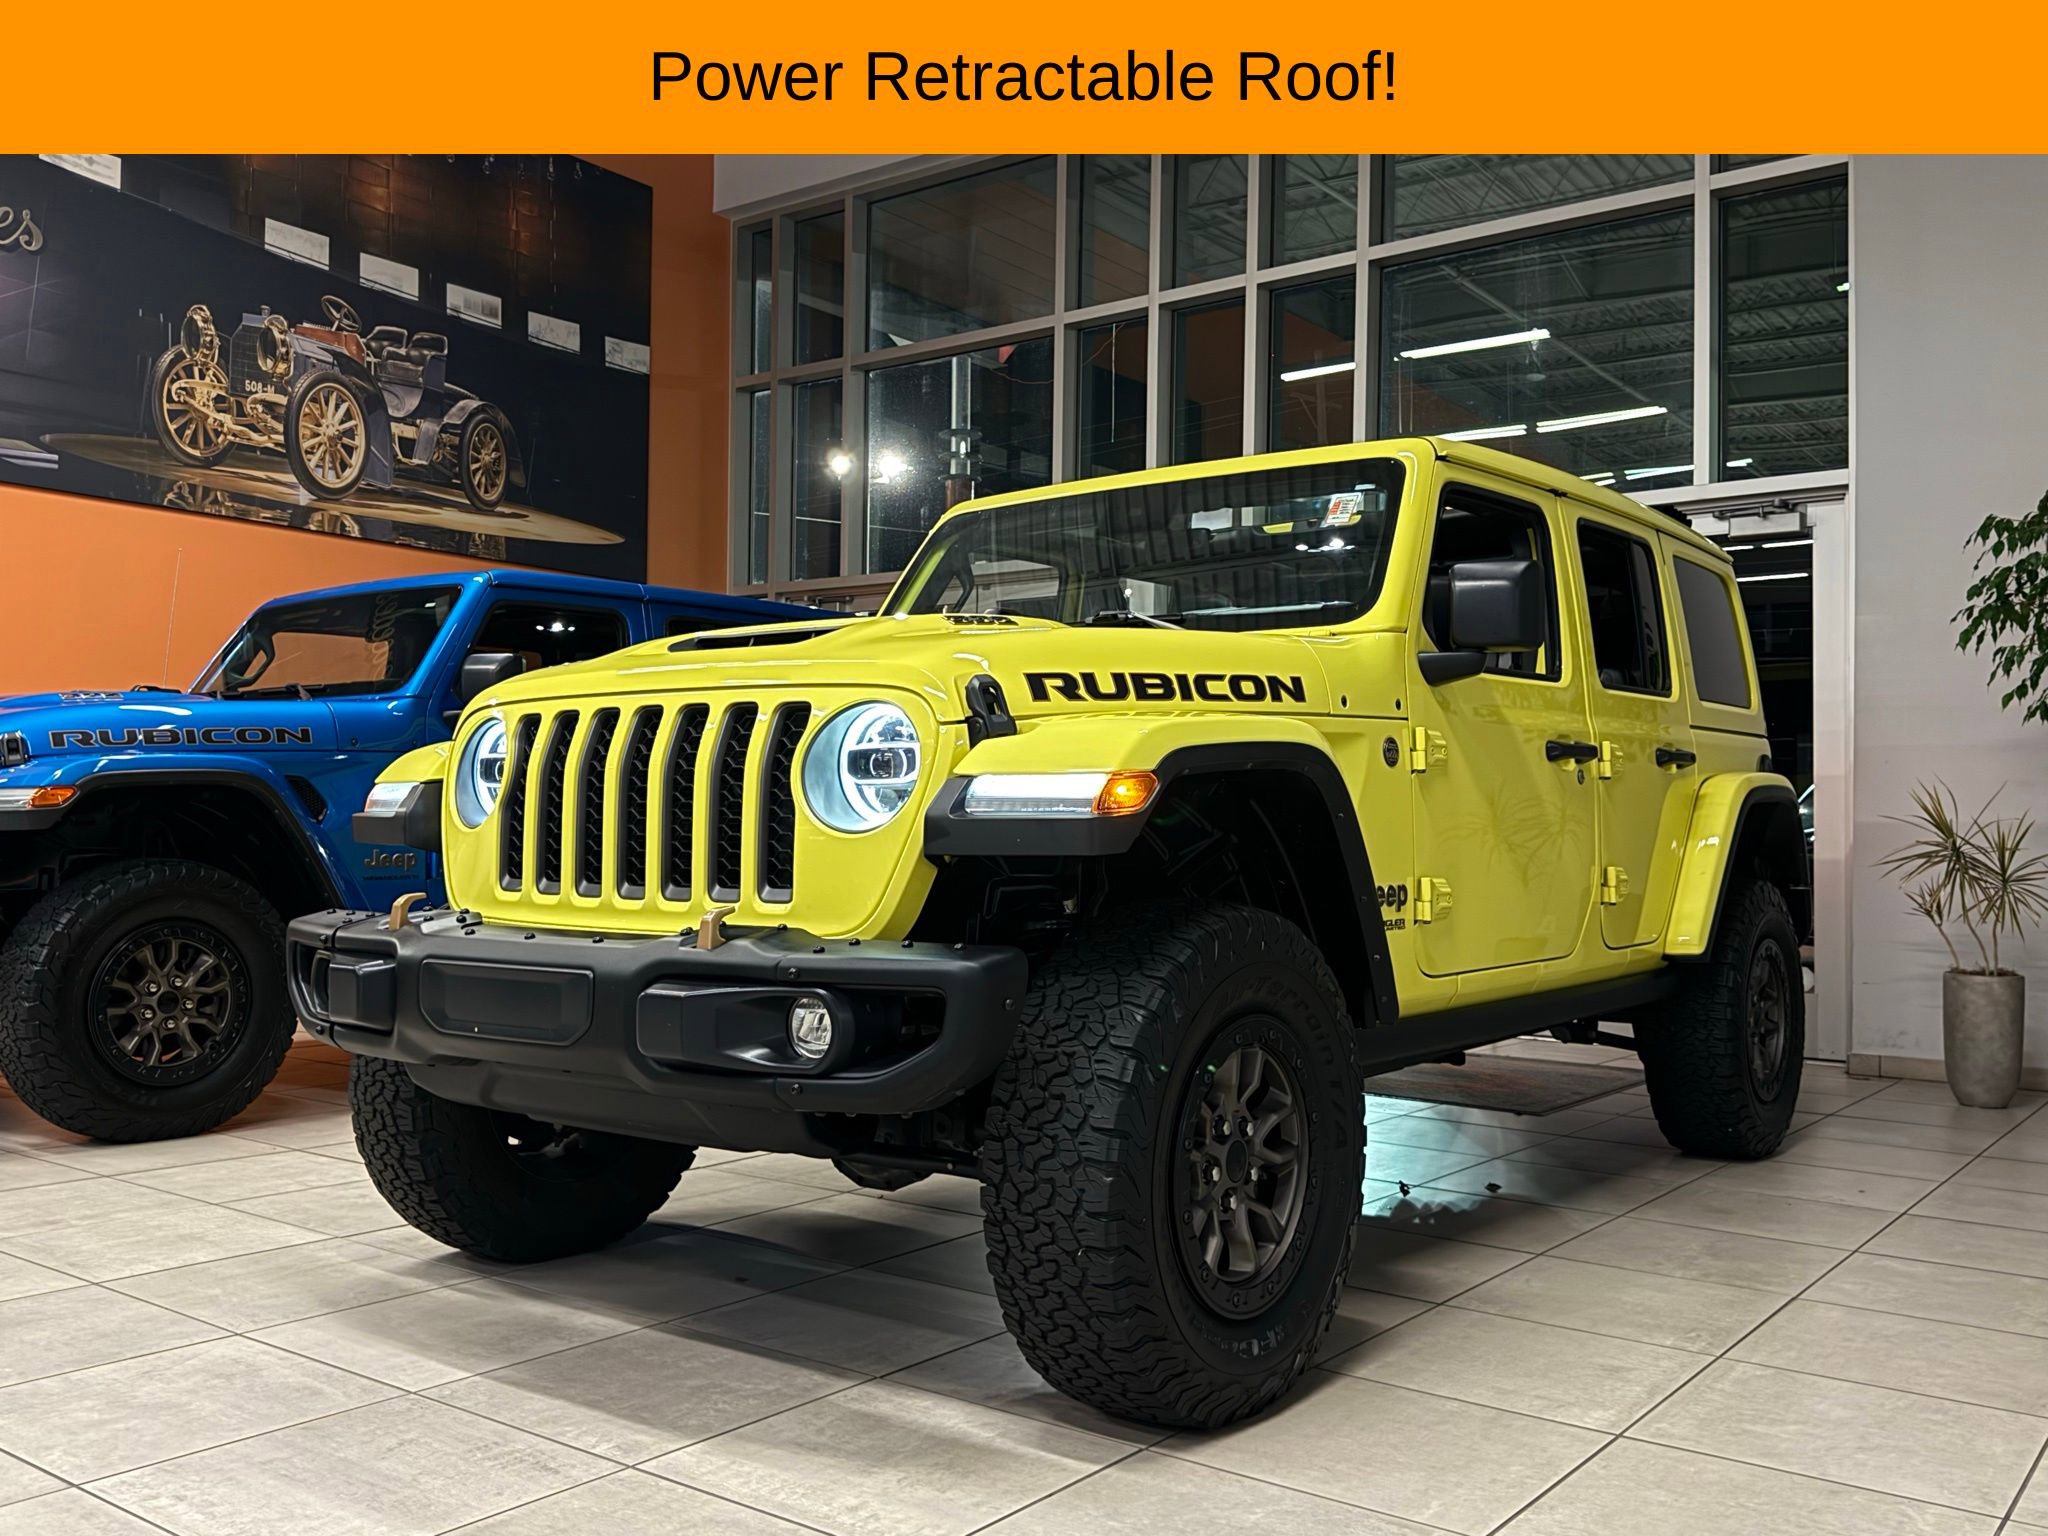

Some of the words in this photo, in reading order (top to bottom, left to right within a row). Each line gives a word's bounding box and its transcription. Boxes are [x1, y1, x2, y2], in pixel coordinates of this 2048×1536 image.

[1022, 671, 1306, 703] RUBICON
[48, 727, 312, 748] RUBICON
[363, 848, 416, 872] Jeep
[1376, 884, 1408, 912] eep
